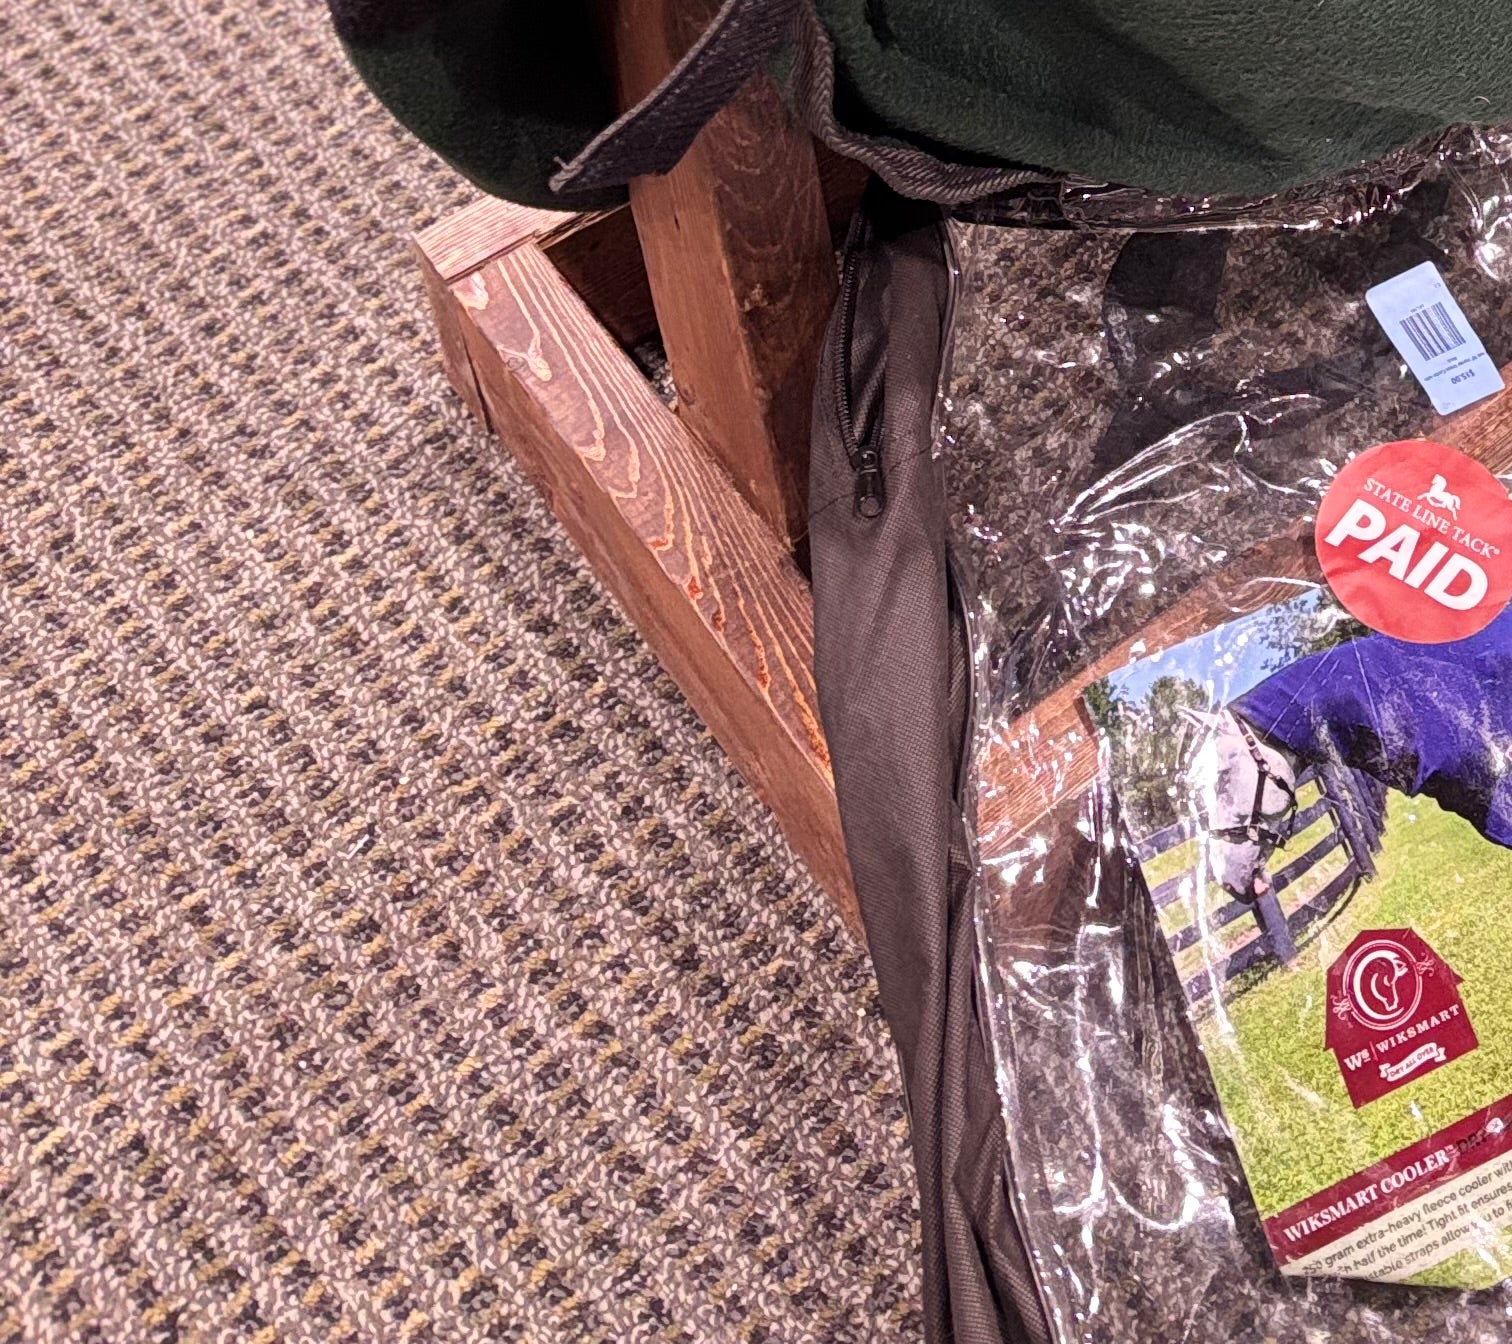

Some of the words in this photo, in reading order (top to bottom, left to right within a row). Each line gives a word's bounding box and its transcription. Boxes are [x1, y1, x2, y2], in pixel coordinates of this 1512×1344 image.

[1450, 368, 1475, 386] $15.00
[1363, 477, 1412, 513] STATE
[1411, 504, 1451, 534] LINE
[1325, 499, 1488, 611] PAID
[1375, 1003, 1460, 1052] WIKSMART
[1405, 1057, 1417, 1069] ALL
[1416, 1046, 1434, 1061] OVER
[1282, 1183, 1381, 1243] WIKSMART
[1323, 1244, 1356, 1268] gram
[1354, 1208, 1423, 1251] extra-heavy
[1421, 1189, 1457, 1214] fleece
[1455, 1170, 1494, 1197] cooler
[1351, 1249, 1378, 1270] half
[1376, 1240, 1397, 1257] the
[1396, 1223, 1428, 1247] time!
[1426, 1208, 1459, 1234] Tight
[1455, 1202, 1470, 1216] fit
[1403, 1239, 1440, 1265] straps
[1438, 1222, 1471, 1245] allow
[1491, 1204, 1505, 1218] to
